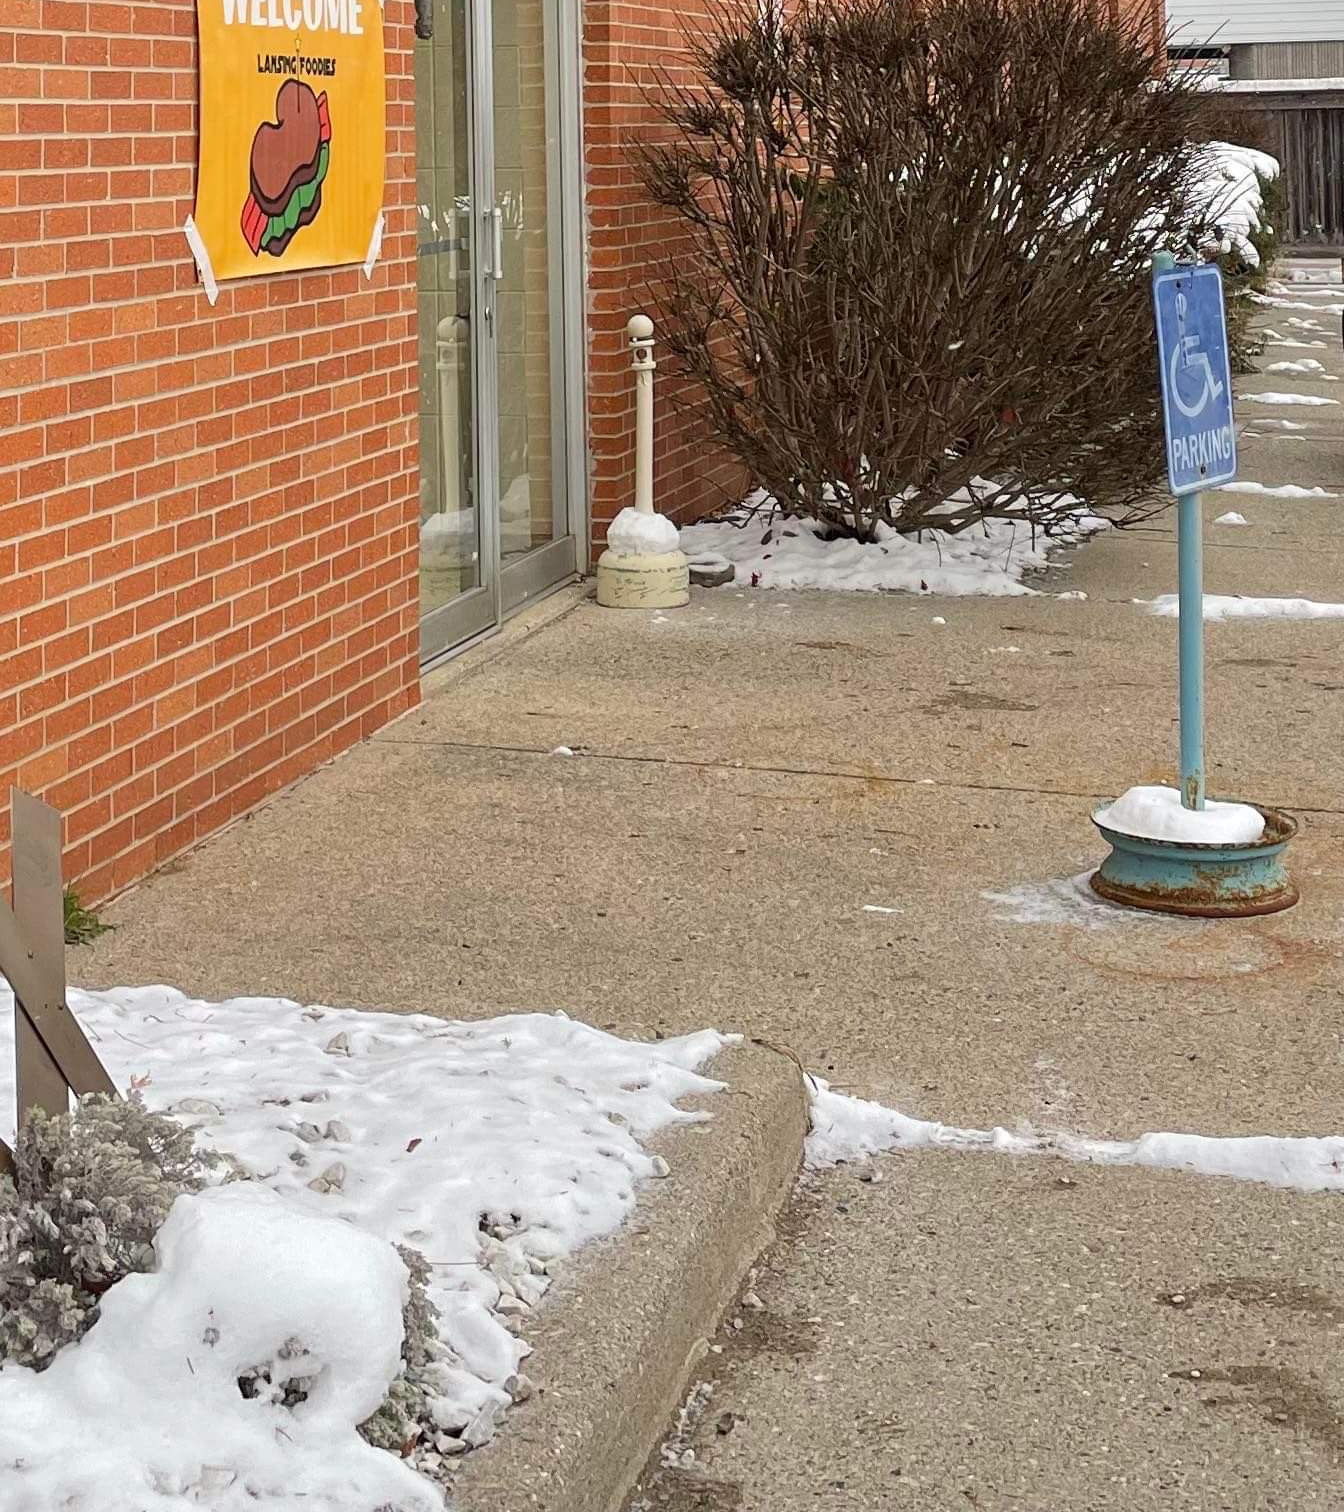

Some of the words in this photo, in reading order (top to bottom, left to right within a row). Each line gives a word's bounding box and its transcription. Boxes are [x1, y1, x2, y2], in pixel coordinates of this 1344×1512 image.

[257, 54, 296, 74] LANSING
[299, 56, 336, 76] FOODIES
[1173, 426, 1231, 472] PARKING
